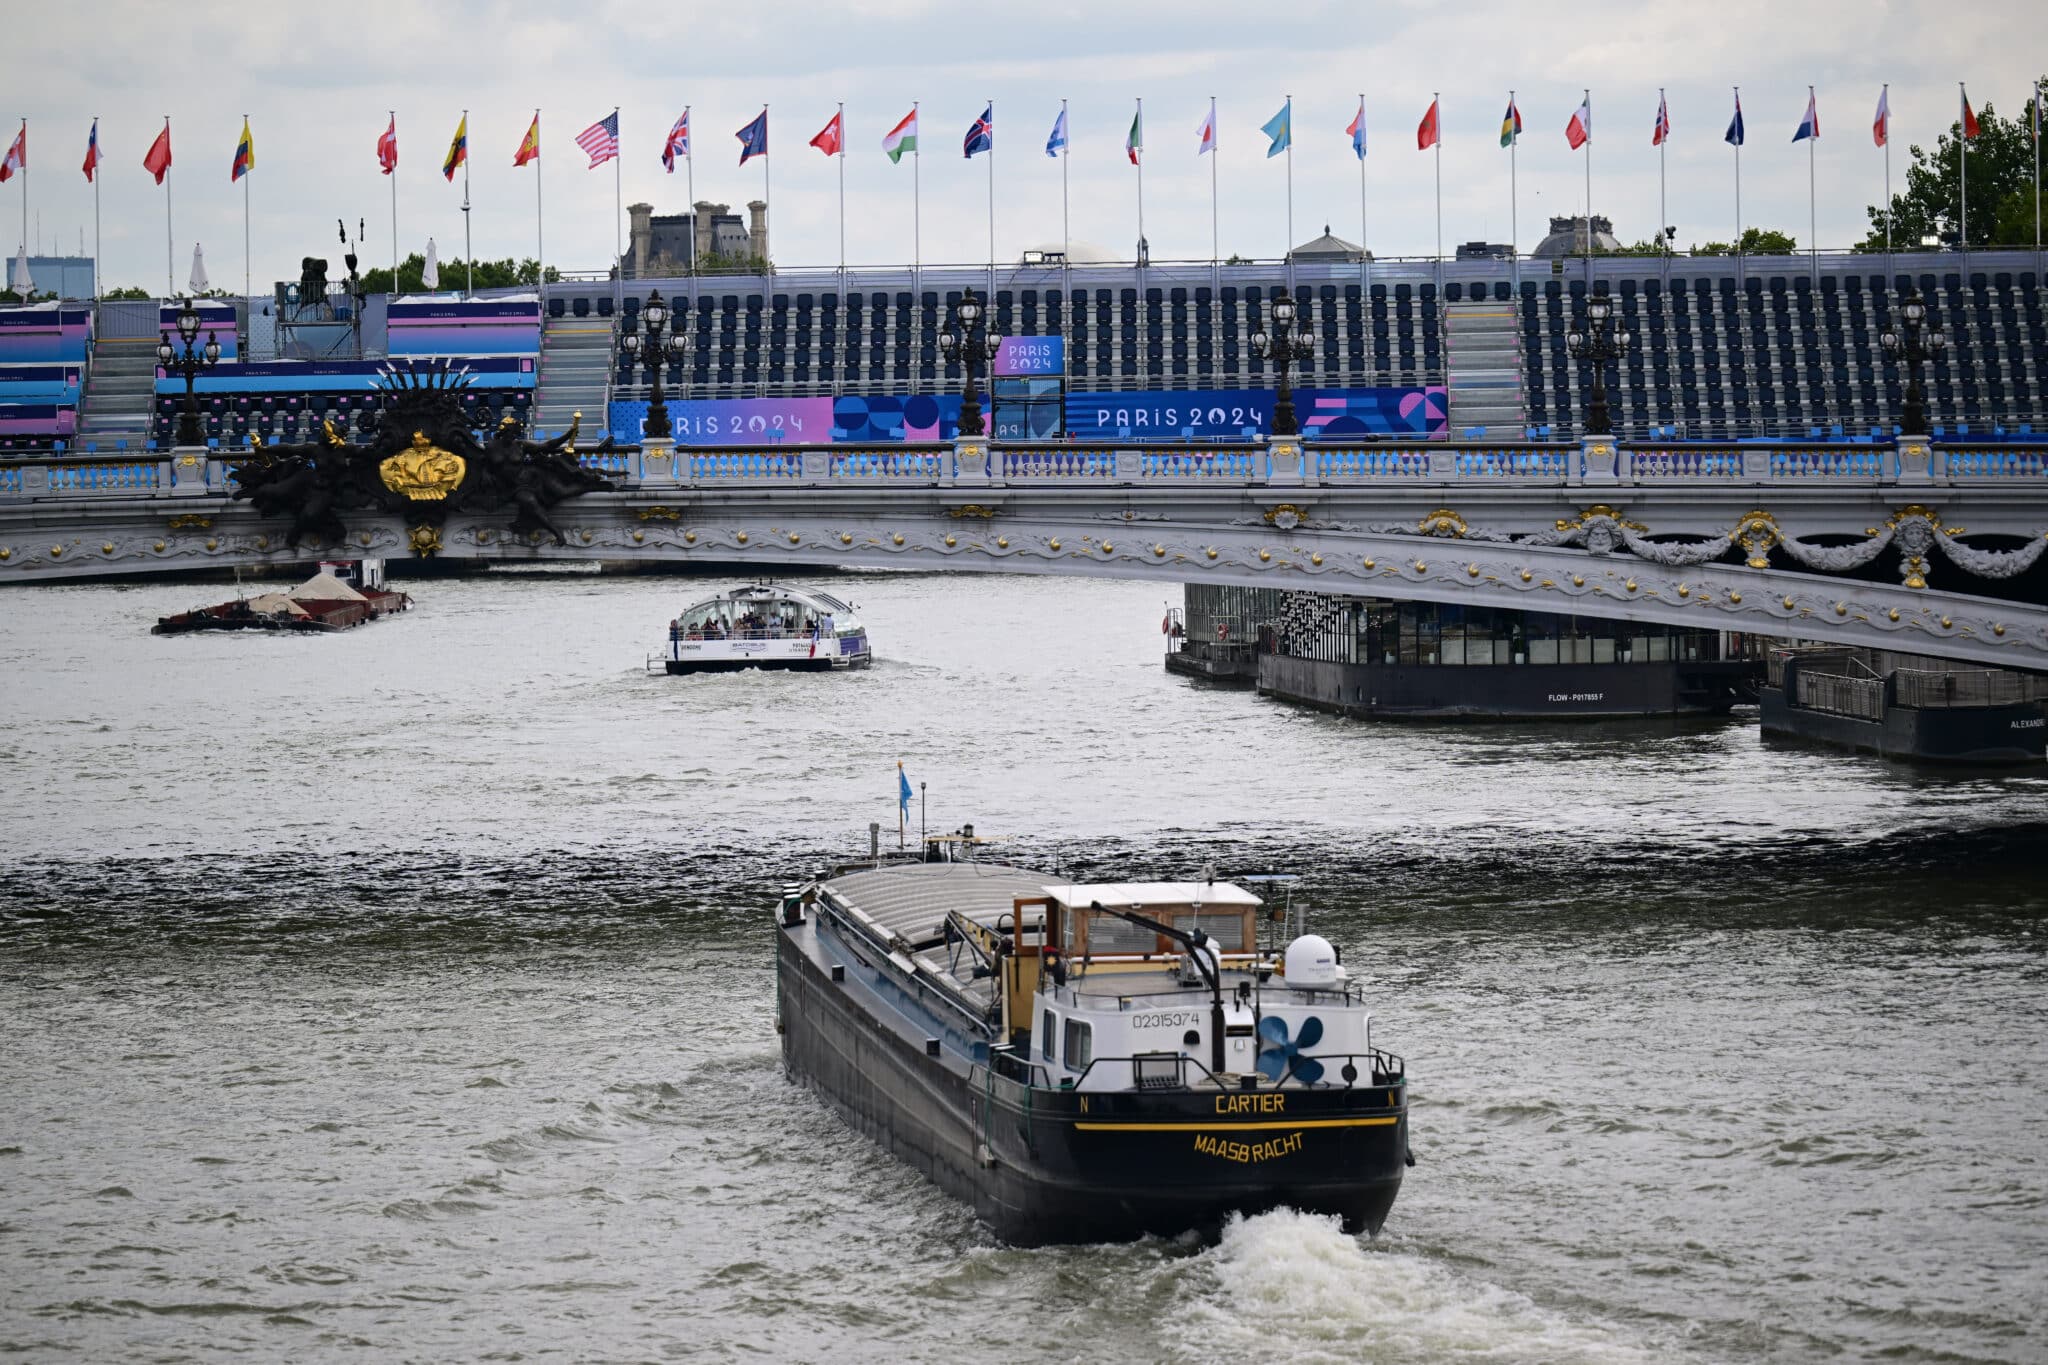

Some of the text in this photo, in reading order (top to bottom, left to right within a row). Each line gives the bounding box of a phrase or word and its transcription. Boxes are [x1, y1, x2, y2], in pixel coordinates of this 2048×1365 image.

[1009, 357, 1051, 370] 2024
[1190, 408, 1263, 426] 2024
[1548, 694, 1568, 702] FLOW
[1132, 1012, 1201, 1029] 02315374
[1080, 1095, 1088, 1113] N
[1215, 1093, 1285, 1114] CARTIER
